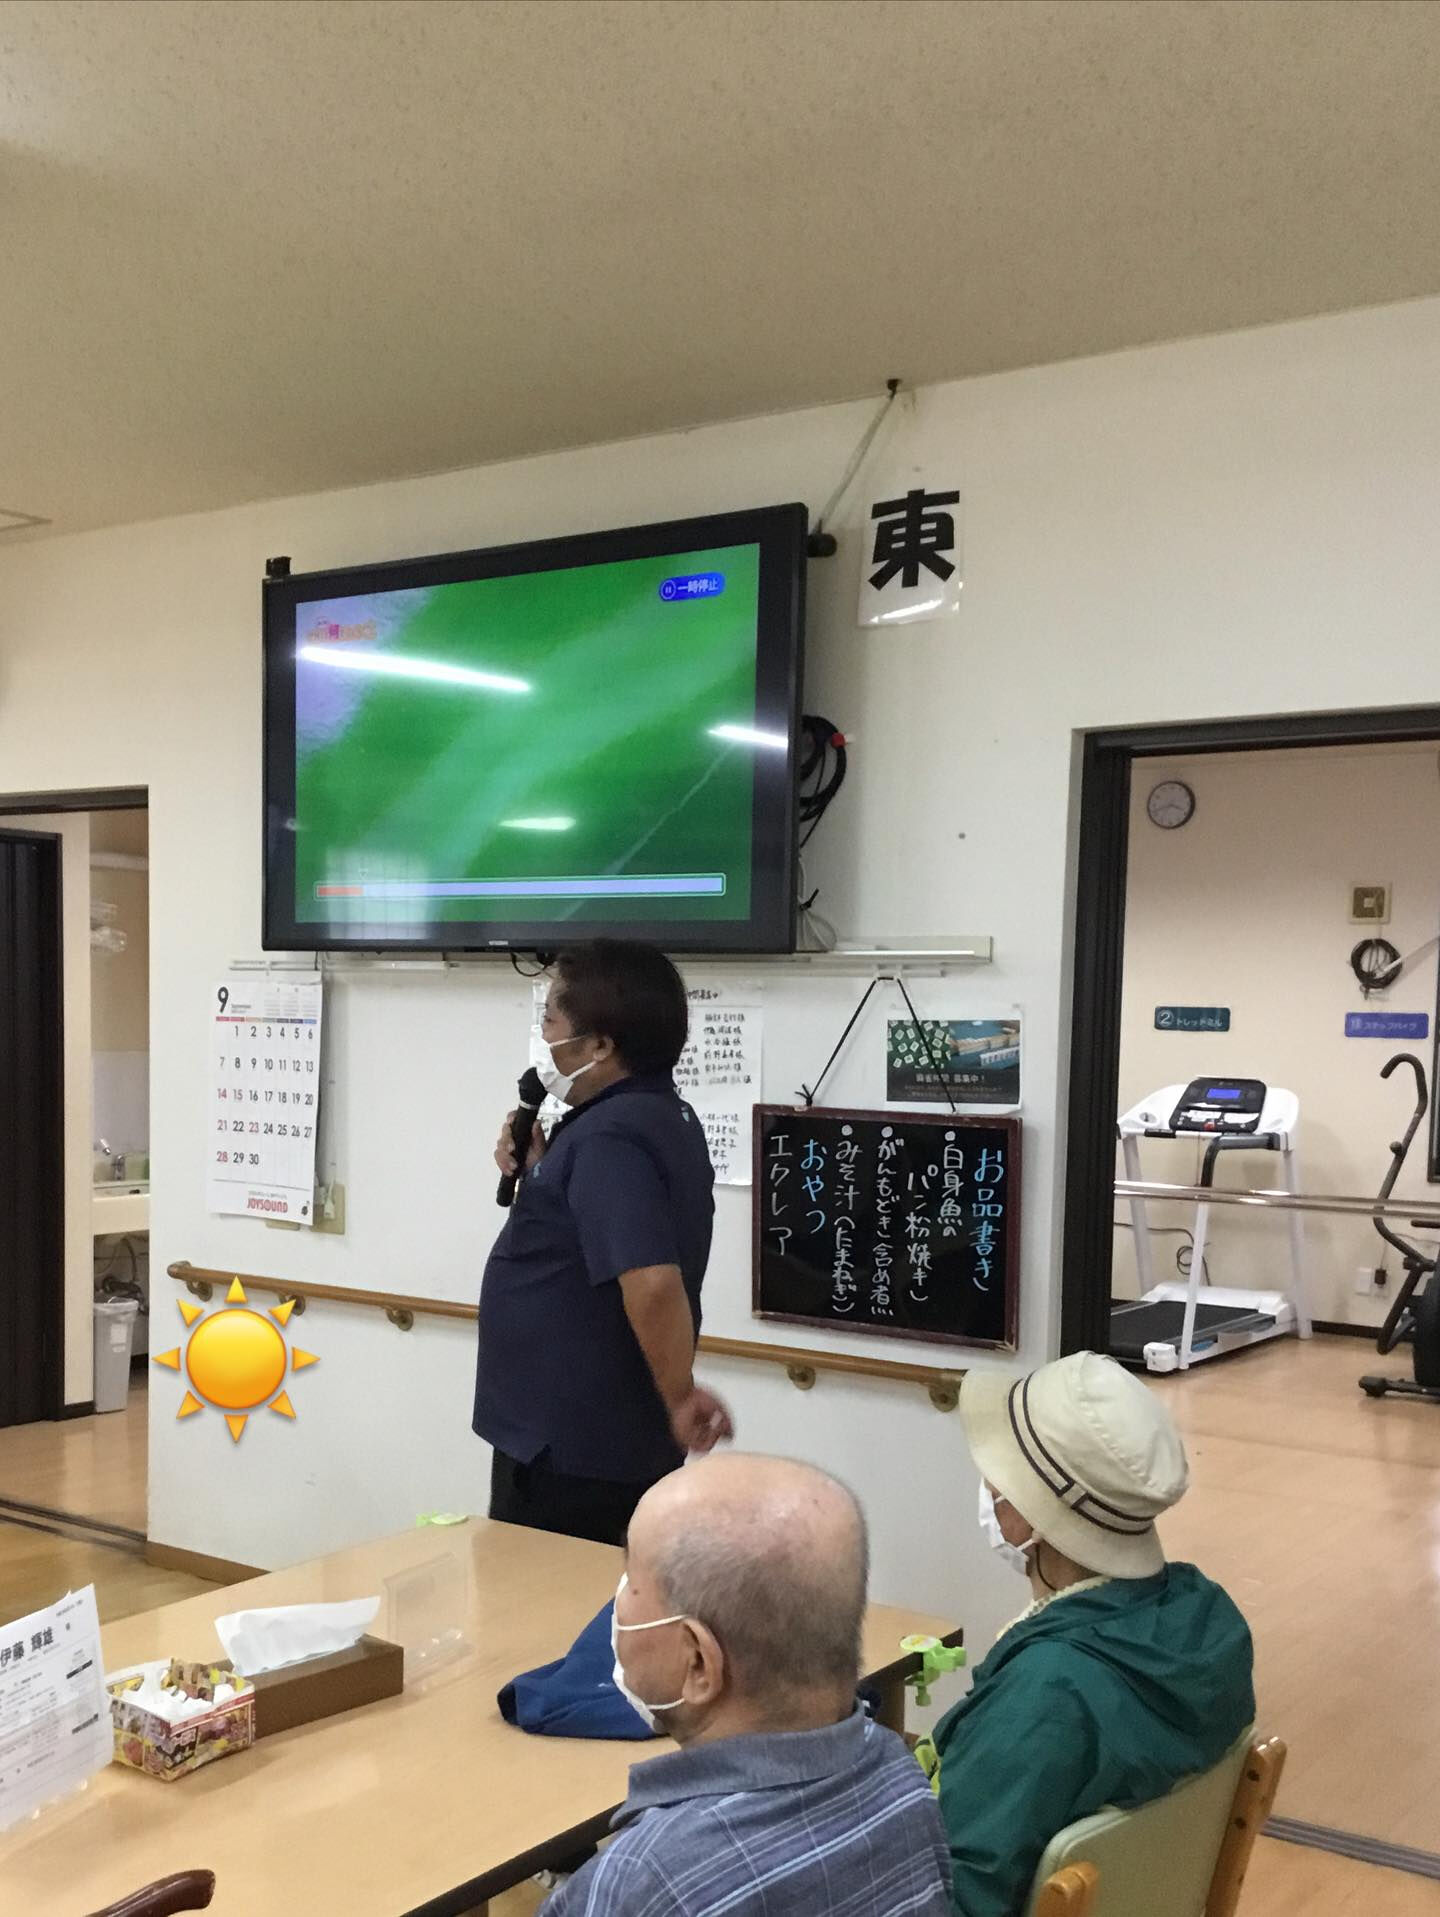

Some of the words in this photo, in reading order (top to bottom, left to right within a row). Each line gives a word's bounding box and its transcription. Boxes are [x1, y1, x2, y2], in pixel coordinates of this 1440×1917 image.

[868, 489, 960, 591] 東
[677, 577, 719, 594] 一時停止
[217, 986, 229, 1014] 9
[235, 1026, 239, 1037] 1
[250, 1026, 257, 1037] 2
[266, 1026, 272, 1038] 3
[280, 1027, 285, 1038] 4
[294, 1028, 300, 1039] 5
[308, 1029, 313, 1039] 6
[219, 1056, 225, 1068] 7
[235, 1057, 241, 1069] 8
[251, 1058, 257, 1069] 9
[264, 1058, 273, 1070] 10
[279, 1059, 287, 1070] 11
[292, 1060, 301, 1072] 12
[306, 1061, 314, 1072] 13
[217, 1088, 227, 1099] 14
[233, 1089, 243, 1100] 15
[249, 1090, 259, 1101] 16
[264, 1091, 273, 1101] 17
[278, 1092, 287, 1103] 18
[292, 1092, 300, 1104] 19
[304, 1094, 313, 1105] 20
[217, 1119, 227, 1131] 21
[233, 1120, 244, 1132] 22
[249, 1121, 259, 1133] 23
[263, 1122, 273, 1134] 24
[278, 1123, 287, 1136] 25
[291, 1125, 300, 1137] 26
[304, 1126, 312, 1138] 27
[216, 1151, 228, 1162] 28
[233, 1152, 244, 1163] 29
[249, 1153, 259, 1165] 30
[769, 1135, 792, 1256] エクレア
[801, 1139, 827, 1234] おやつ
[938, 1144, 964, 1236] 白身魚の
[247, 1198, 288, 1213] JOYSOUND
[870, 1138, 904, 1316] がんもどき含め煮
[904, 1164, 939, 1301] パン粉焼き
[969, 1148, 1004, 1292] お品書き
